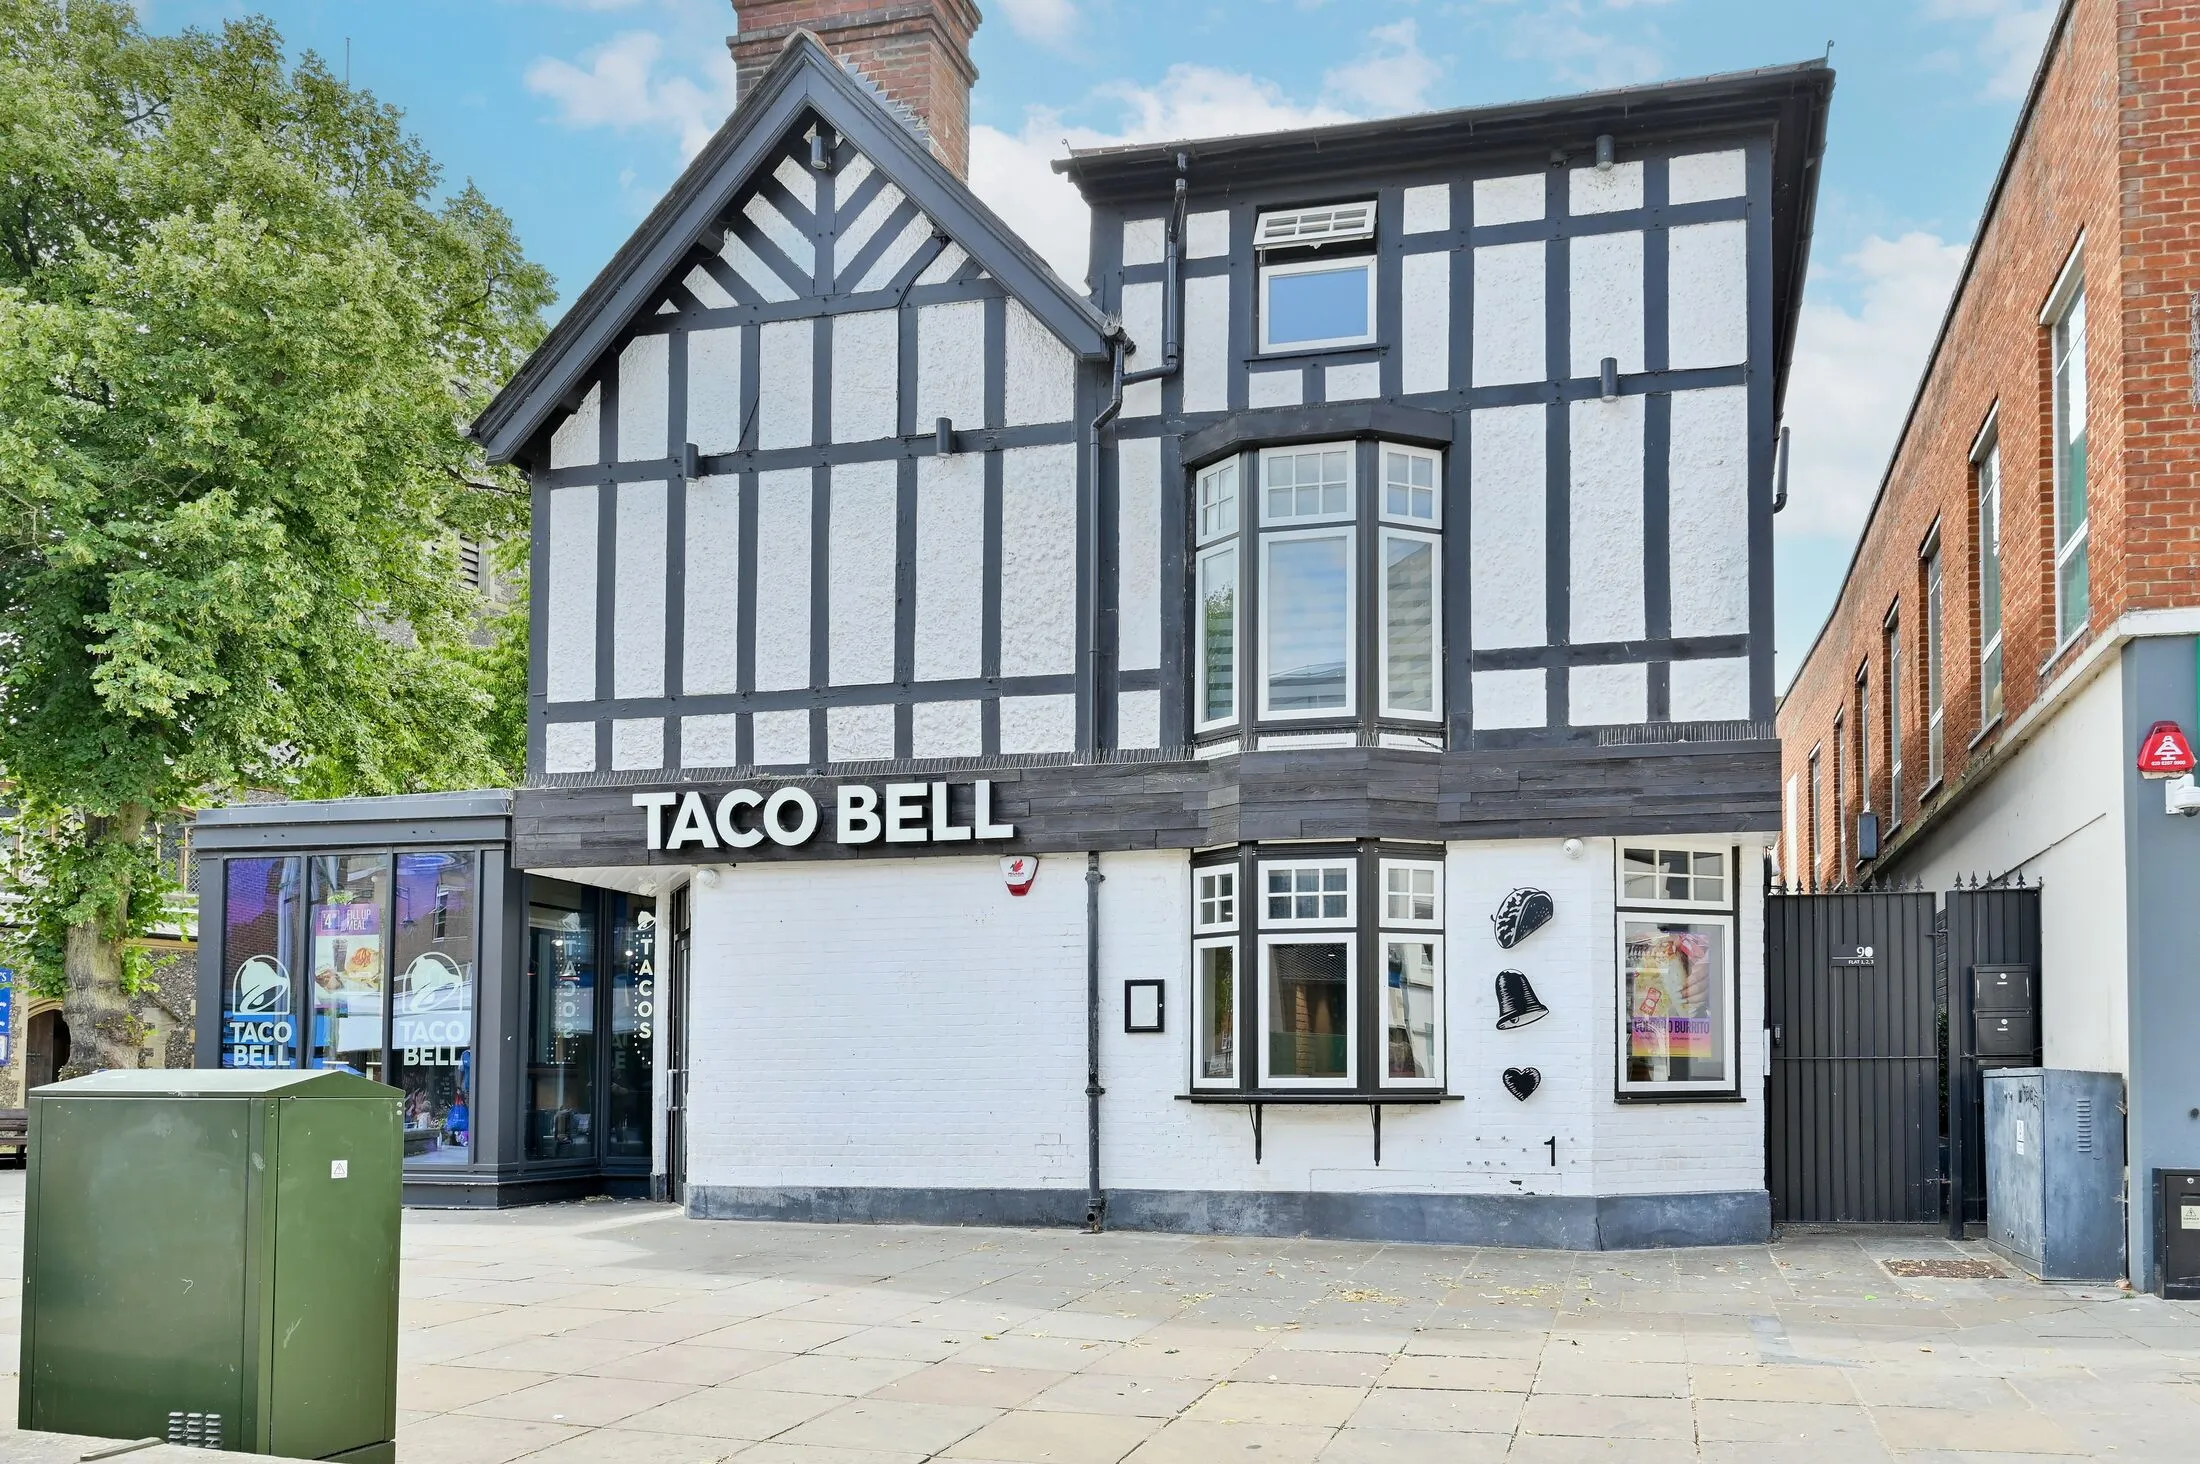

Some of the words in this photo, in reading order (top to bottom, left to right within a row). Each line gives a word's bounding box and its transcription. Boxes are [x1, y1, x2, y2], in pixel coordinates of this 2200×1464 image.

[632, 786, 818, 850] TACO
[837, 779, 1014, 844] BELL
[347, 909, 361, 920] FILL
[361, 908, 371, 920] UP
[347, 920, 367, 930] MEAL
[1856, 946, 1874, 958] 90
[638, 938, 654, 1039] TACOS
[230, 1021, 292, 1043] TACO
[400, 1020, 465, 1043] TACO
[1674, 1021, 1710, 1034] BURRITO
[233, 1045, 291, 1066] BELL
[403, 1044, 463, 1066] BELL
[1543, 1135, 1556, 1167] 1
